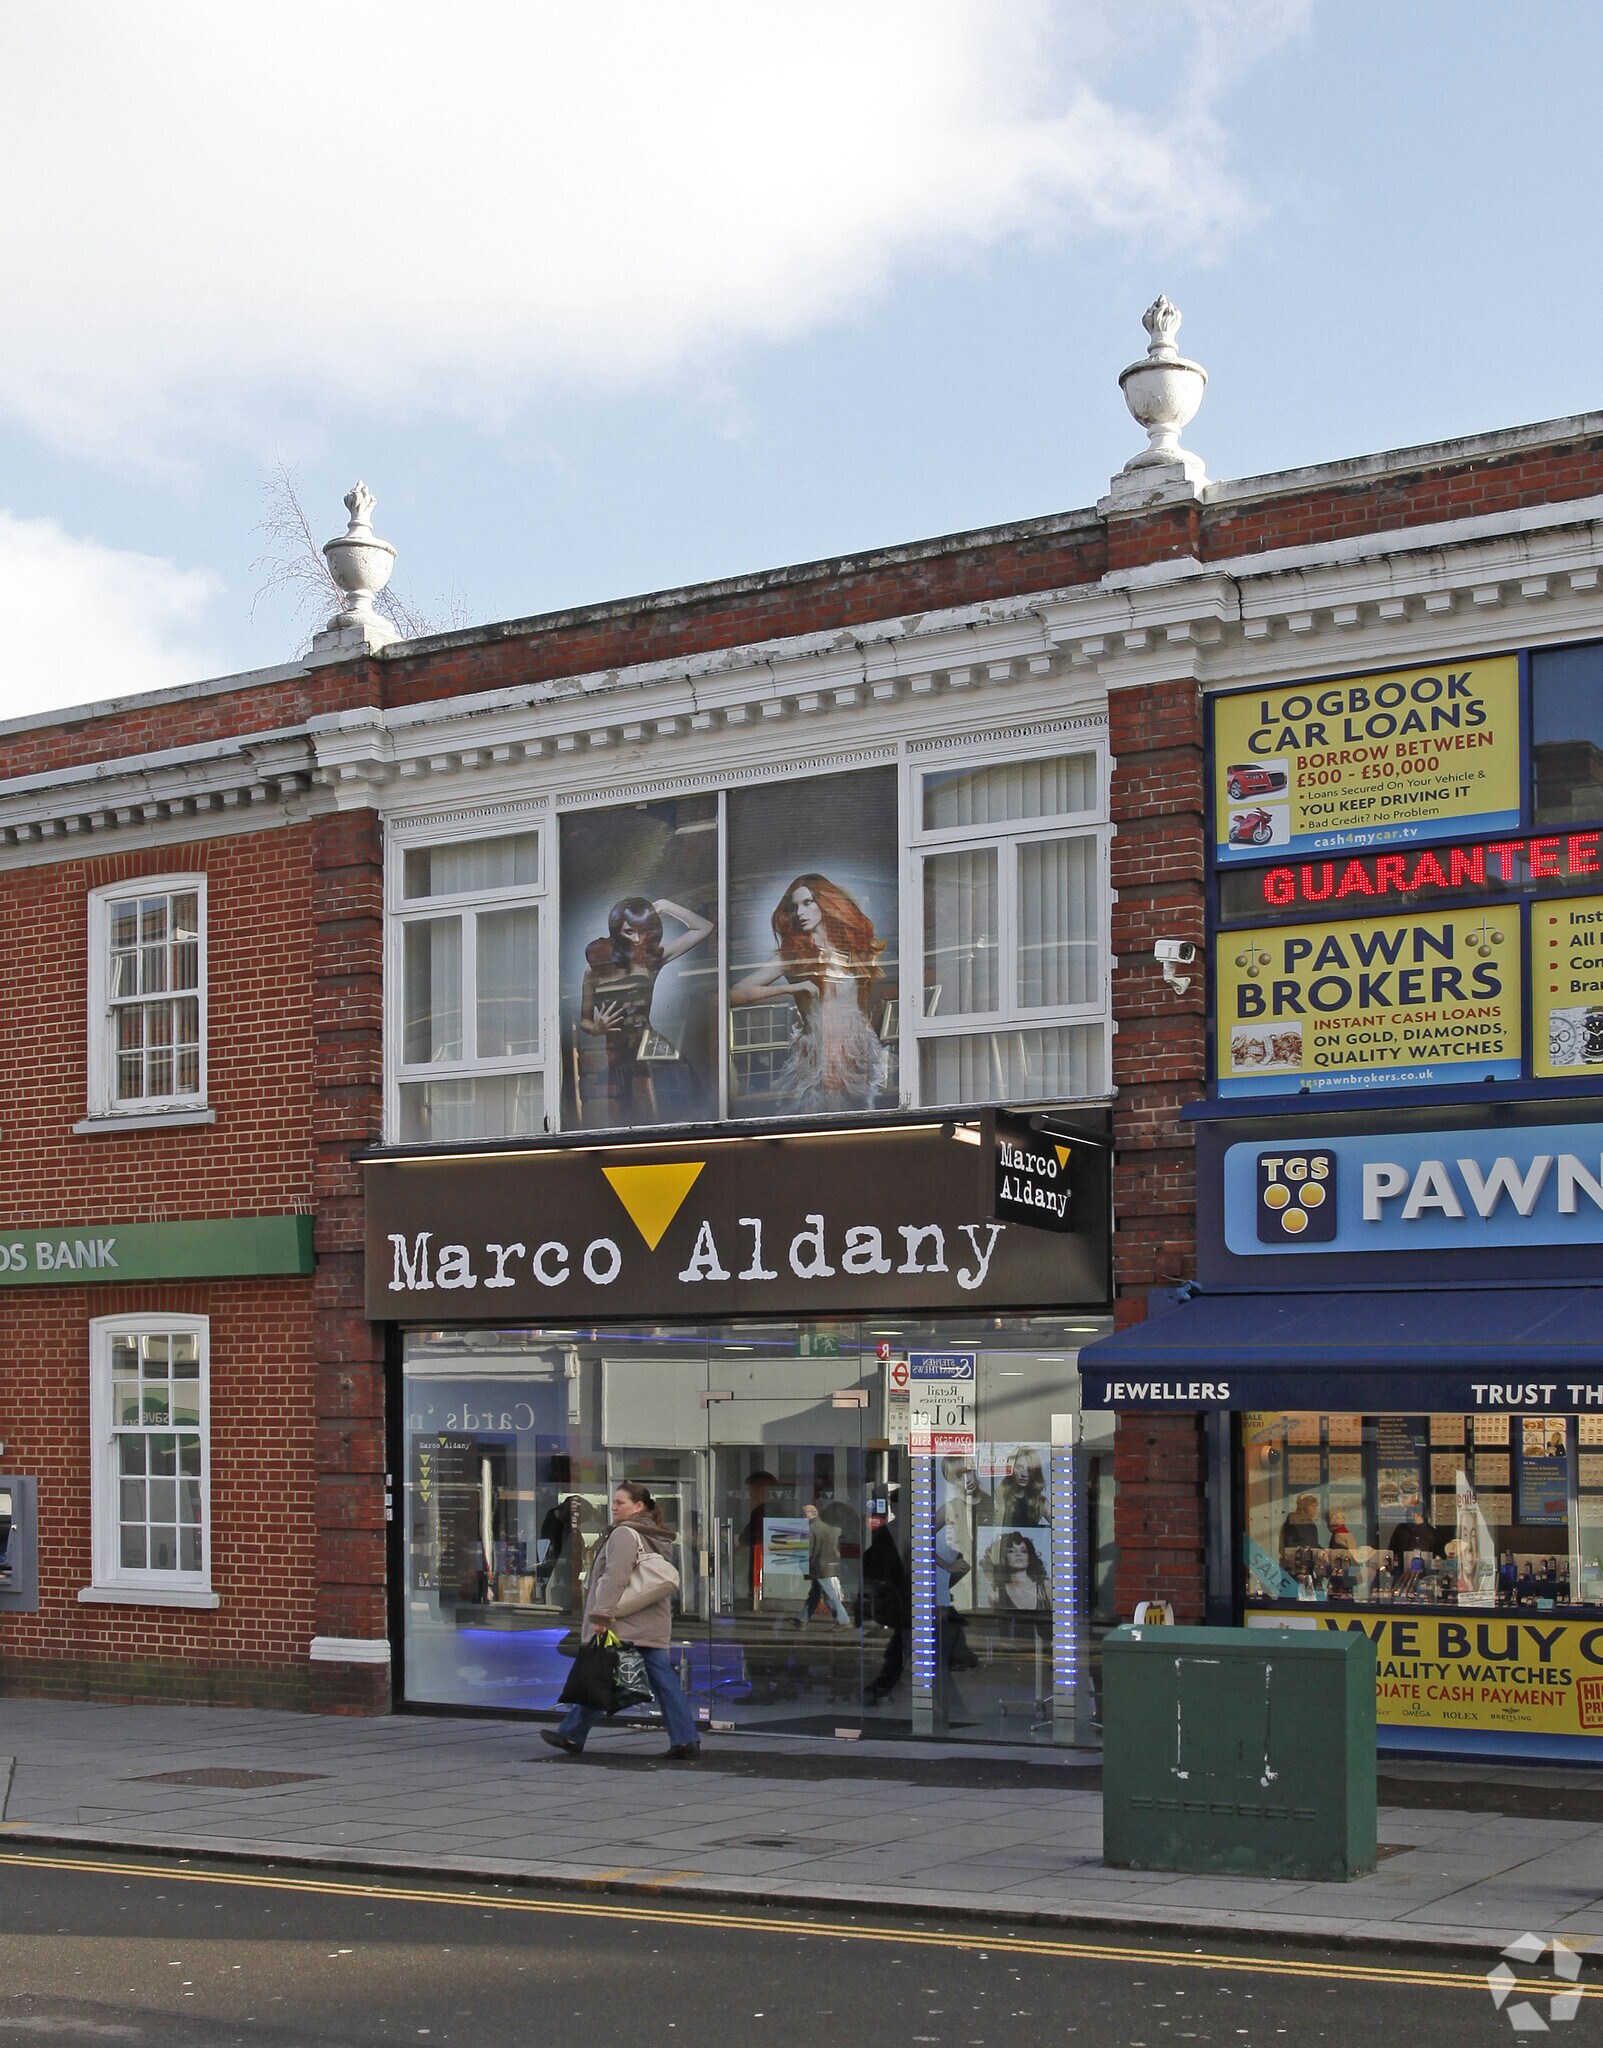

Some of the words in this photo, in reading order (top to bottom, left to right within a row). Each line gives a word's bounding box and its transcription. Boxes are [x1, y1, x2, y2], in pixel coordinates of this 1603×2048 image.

[1261, 671, 1473, 725] LOGBOOK
[1248, 722, 1330, 754] CAR
[1344, 700, 1487, 743] LOANS
[1297, 745, 1389, 770] BORROW
[1395, 731, 1494, 758] BETWEEN
[1297, 769, 1342, 788] £500
[1361, 756, 1440, 780] £50,000
[1308, 789, 1339, 800] Loans
[1341, 782, 1384, 795] Secured
[1387, 781, 1404, 790] On
[1407, 778, 1432, 788] Your
[1435, 771, 1474, 784] Vehicle
[1477, 770, 1486, 778] &
[1299, 802, 1335, 816] YOU
[1340, 797, 1377, 811] KEEP
[1381, 788, 1450, 807] DRIVING
[1455, 785, 1471, 798] IT
[1308, 818, 1329, 829] Bad
[1331, 814, 1370, 827] Credit?
[1374, 812, 1390, 821] No
[1393, 806, 1440, 819] Problem
[1314, 827, 1418, 847] cash4mycar.tv
[1263, 833, 1601, 904] GUARANTEE
[1284, 924, 1454, 974] PAWN
[1569, 931, 1595, 948] All
[1237, 961, 1502, 1019] BROKERS
[1313, 1014, 1386, 1031] INSTANT
[1391, 1010, 1437, 1025] CASH
[1442, 1005, 1501, 1020] LOANS
[1313, 1035, 1340, 1047] ON
[1345, 1031, 1398, 1045] GOLD,
[1403, 1022, 1508, 1041] DIAMONDS,
[1313, 1047, 1402, 1067] QUALITY
[1408, 1040, 1504, 1059] WATCHES
[1300, 1069, 1434, 1089] tgspawnbrokers.co.uk
[1000, 1140, 1058, 1178] Marco
[1261, 1156, 1330, 1182] TGS
[1000, 1175, 1068, 1217] Aldany
[1362, 1151, 1603, 1222] PAWN
[36, 1239, 120, 1270] BANK
[387, 1231, 622, 1291] Marco
[678, 1214, 1007, 1291] Aldany
[1103, 1382, 1230, 1403] JEWELLERS
[1471, 1383, 1557, 1404] TRUST
[419, 1441, 441, 1449] Marco
[1251, 1552, 1292, 1593] SALE
[1438, 1622, 1568, 1663] BUY
[1457, 1663, 1572, 1686] WATCHES
[1426, 1685, 1474, 1702] CASH
[1481, 1687, 1567, 1707] PAYMENT
[1583, 1683, 1603, 1700] HI
[1402, 1709, 1431, 1718] OMEGA
[1443, 1711, 1478, 1721] ROLEX
[1490, 1713, 1532, 1722] BREITLING
